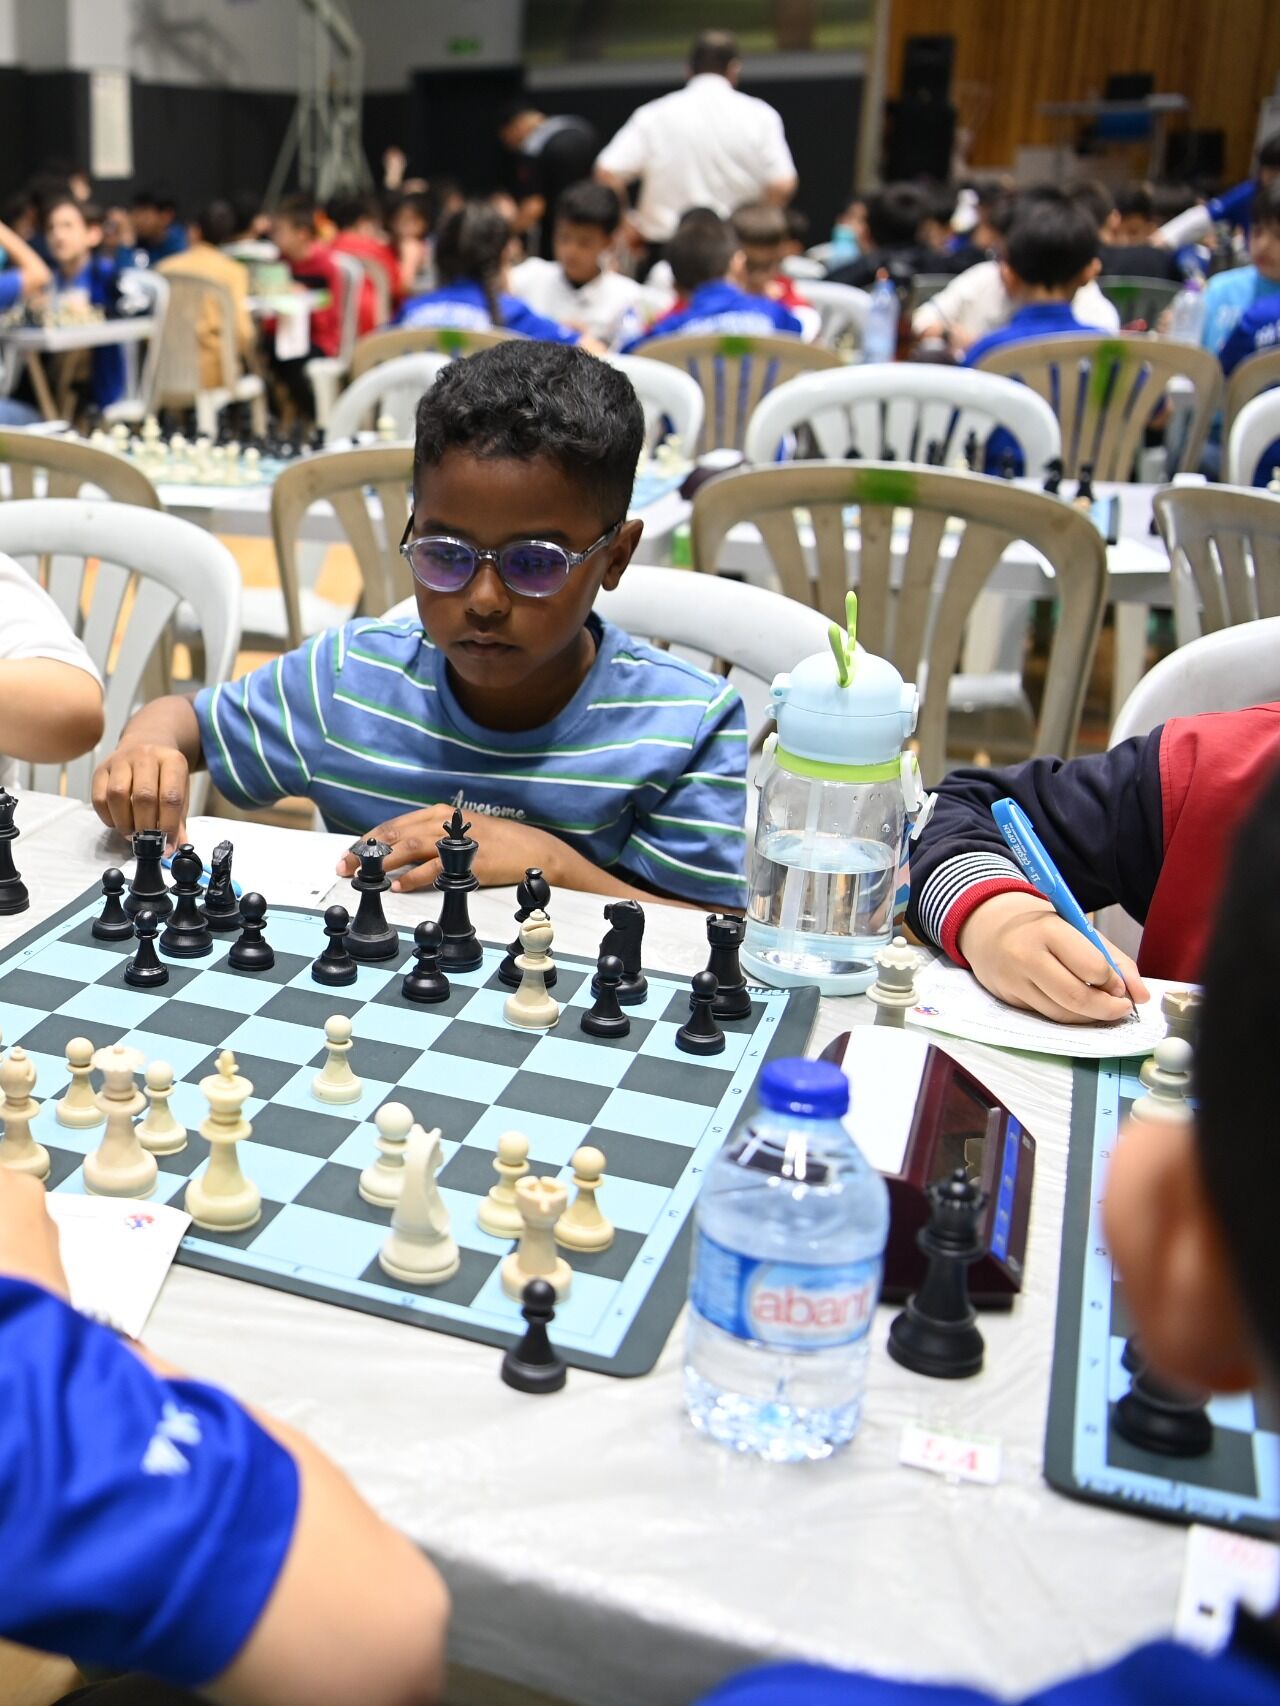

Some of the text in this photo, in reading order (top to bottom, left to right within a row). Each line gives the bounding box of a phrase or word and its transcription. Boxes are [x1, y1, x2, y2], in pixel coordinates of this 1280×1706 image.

[450, 789, 527, 820] Awesome
[731, 1087, 742, 1095] 6
[1103, 1108, 1113, 1116] 2
[712, 1126, 723, 1134] 5
[691, 1166, 703, 1175] 4
[642, 1255, 655, 1264] 2
